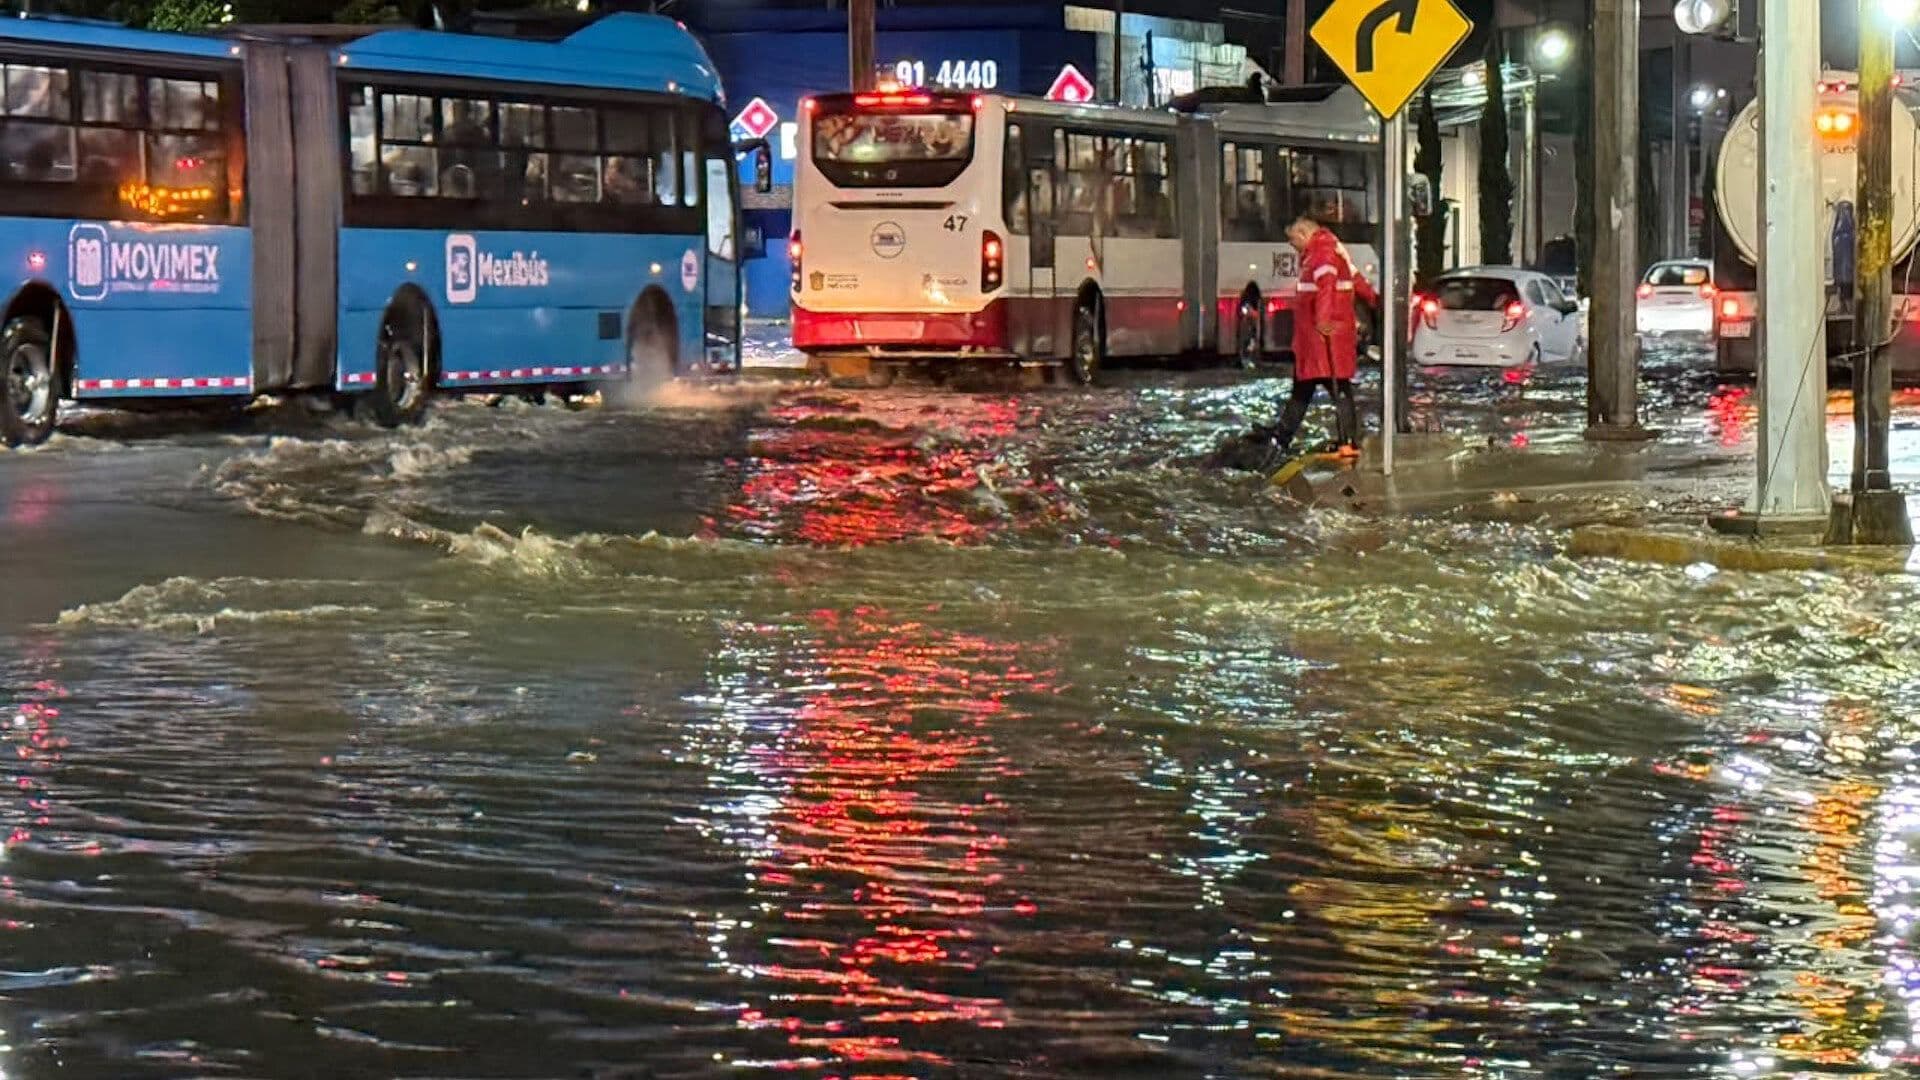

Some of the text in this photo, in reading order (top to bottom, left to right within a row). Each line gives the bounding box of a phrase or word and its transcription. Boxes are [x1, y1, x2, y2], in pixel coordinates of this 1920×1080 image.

[943, 214, 968, 231] 47
[111, 242, 219, 281] MOVIMEX
[478, 250, 549, 287] Mexibús
